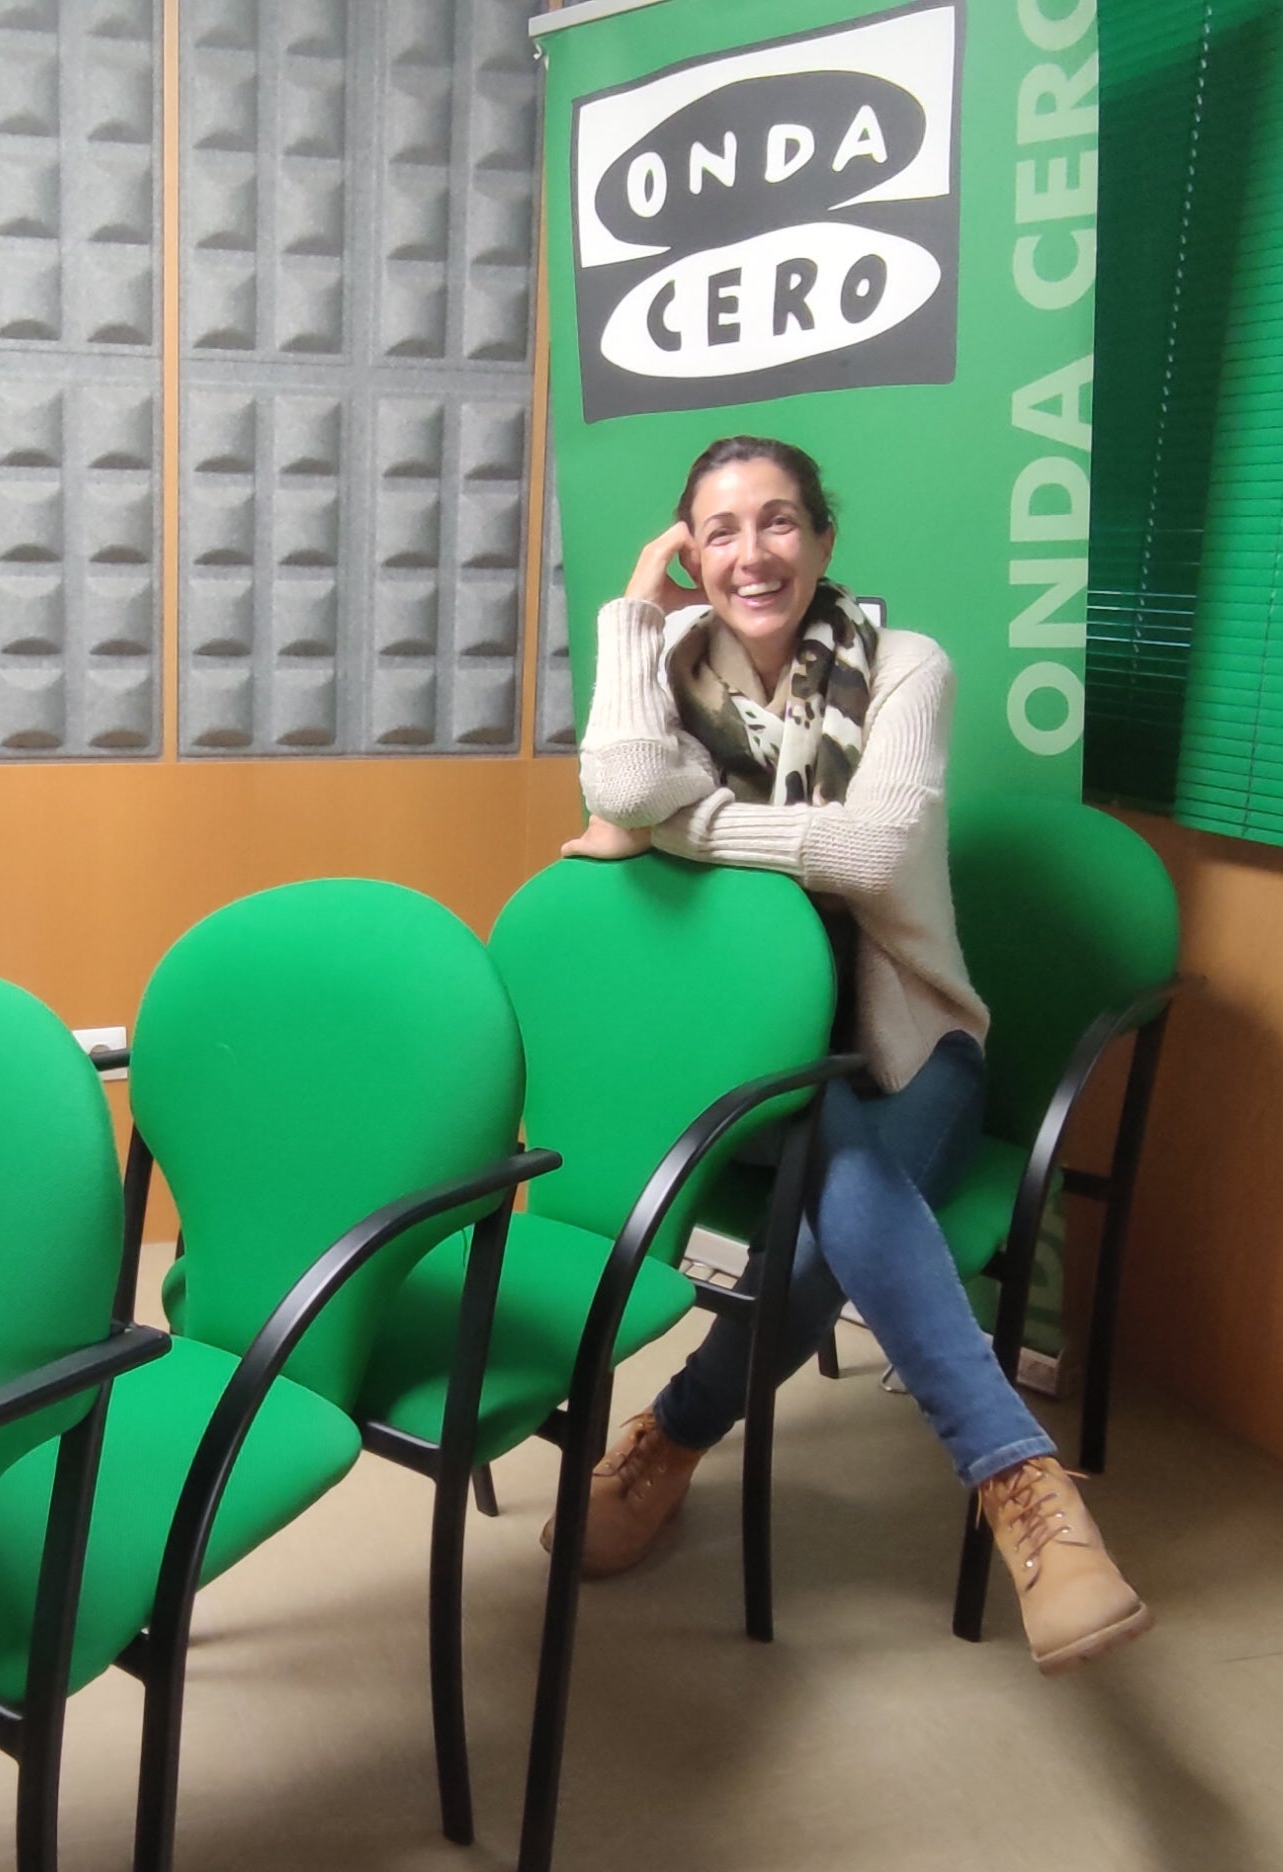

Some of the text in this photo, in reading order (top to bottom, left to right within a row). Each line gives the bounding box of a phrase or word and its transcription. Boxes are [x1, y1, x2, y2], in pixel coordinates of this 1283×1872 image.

[626, 104, 888, 218] ONDA
[646, 253, 888, 352] CERO
[1007, 353, 1094, 756] ONDA
